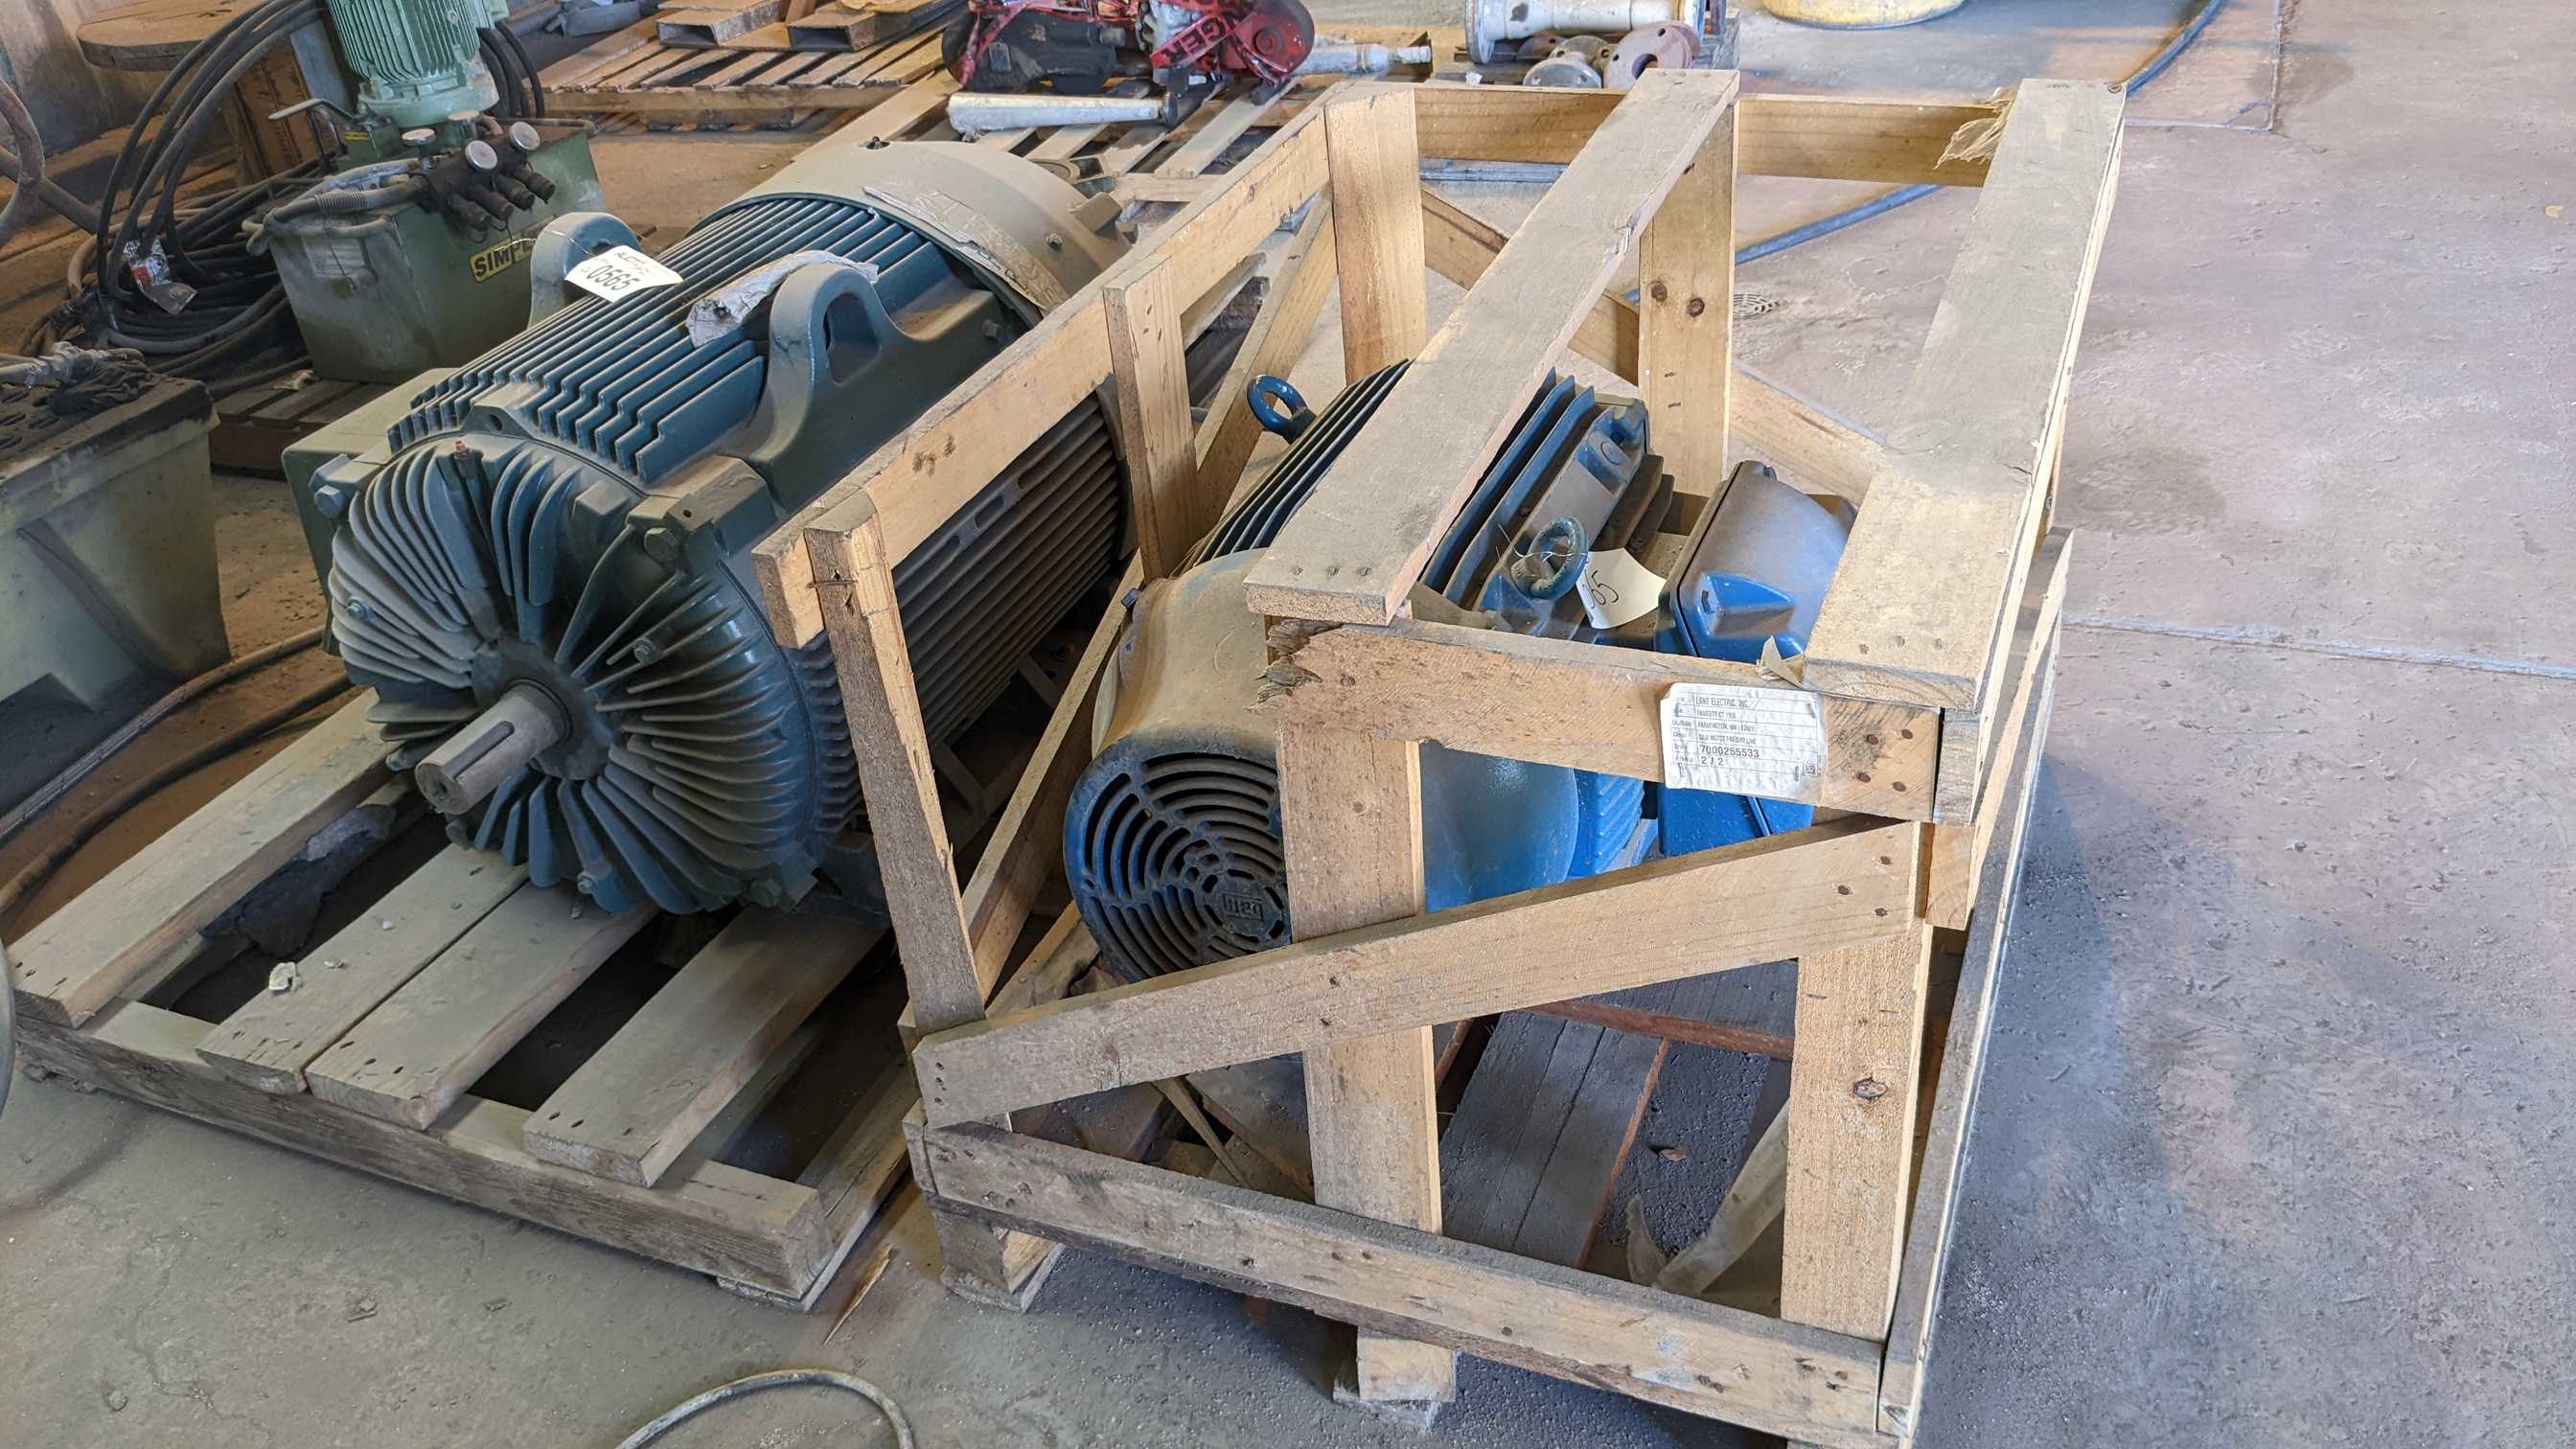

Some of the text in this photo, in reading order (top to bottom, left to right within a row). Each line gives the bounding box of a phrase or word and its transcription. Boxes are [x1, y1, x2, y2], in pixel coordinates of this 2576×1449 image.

[586, 264, 641, 290] 0565
[1699, 745, 1760, 758] 7000255533
[1701, 756, 1707, 765] 2
[1717, 757, 1724, 766] 2
